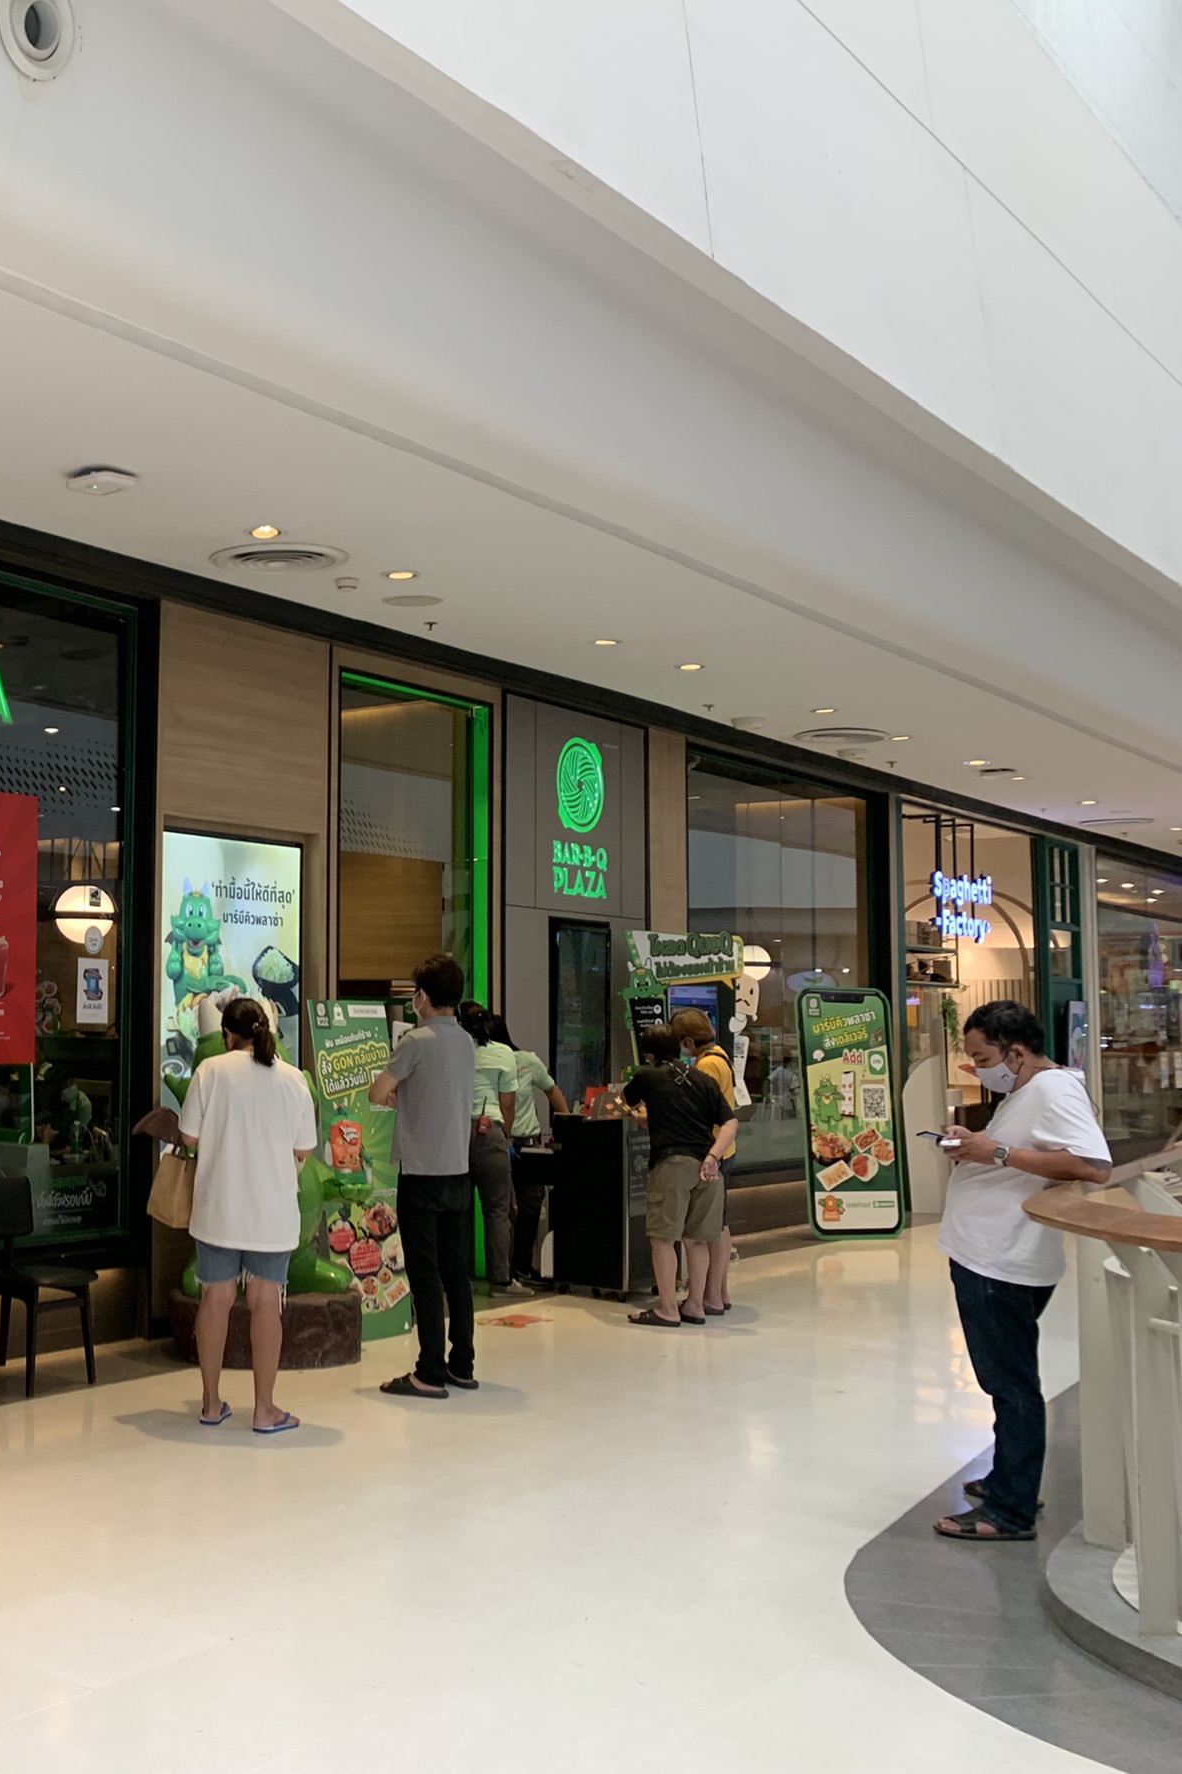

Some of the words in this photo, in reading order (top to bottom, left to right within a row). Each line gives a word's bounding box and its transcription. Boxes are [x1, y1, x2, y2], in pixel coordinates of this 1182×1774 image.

[552, 866, 608, 899] PLAZA
[933, 870, 992, 905] Spaghetti
[686, 931, 734, 959] QueQ
[333, 1054, 354, 1071] GON
[843, 1050, 863, 1063] Add
